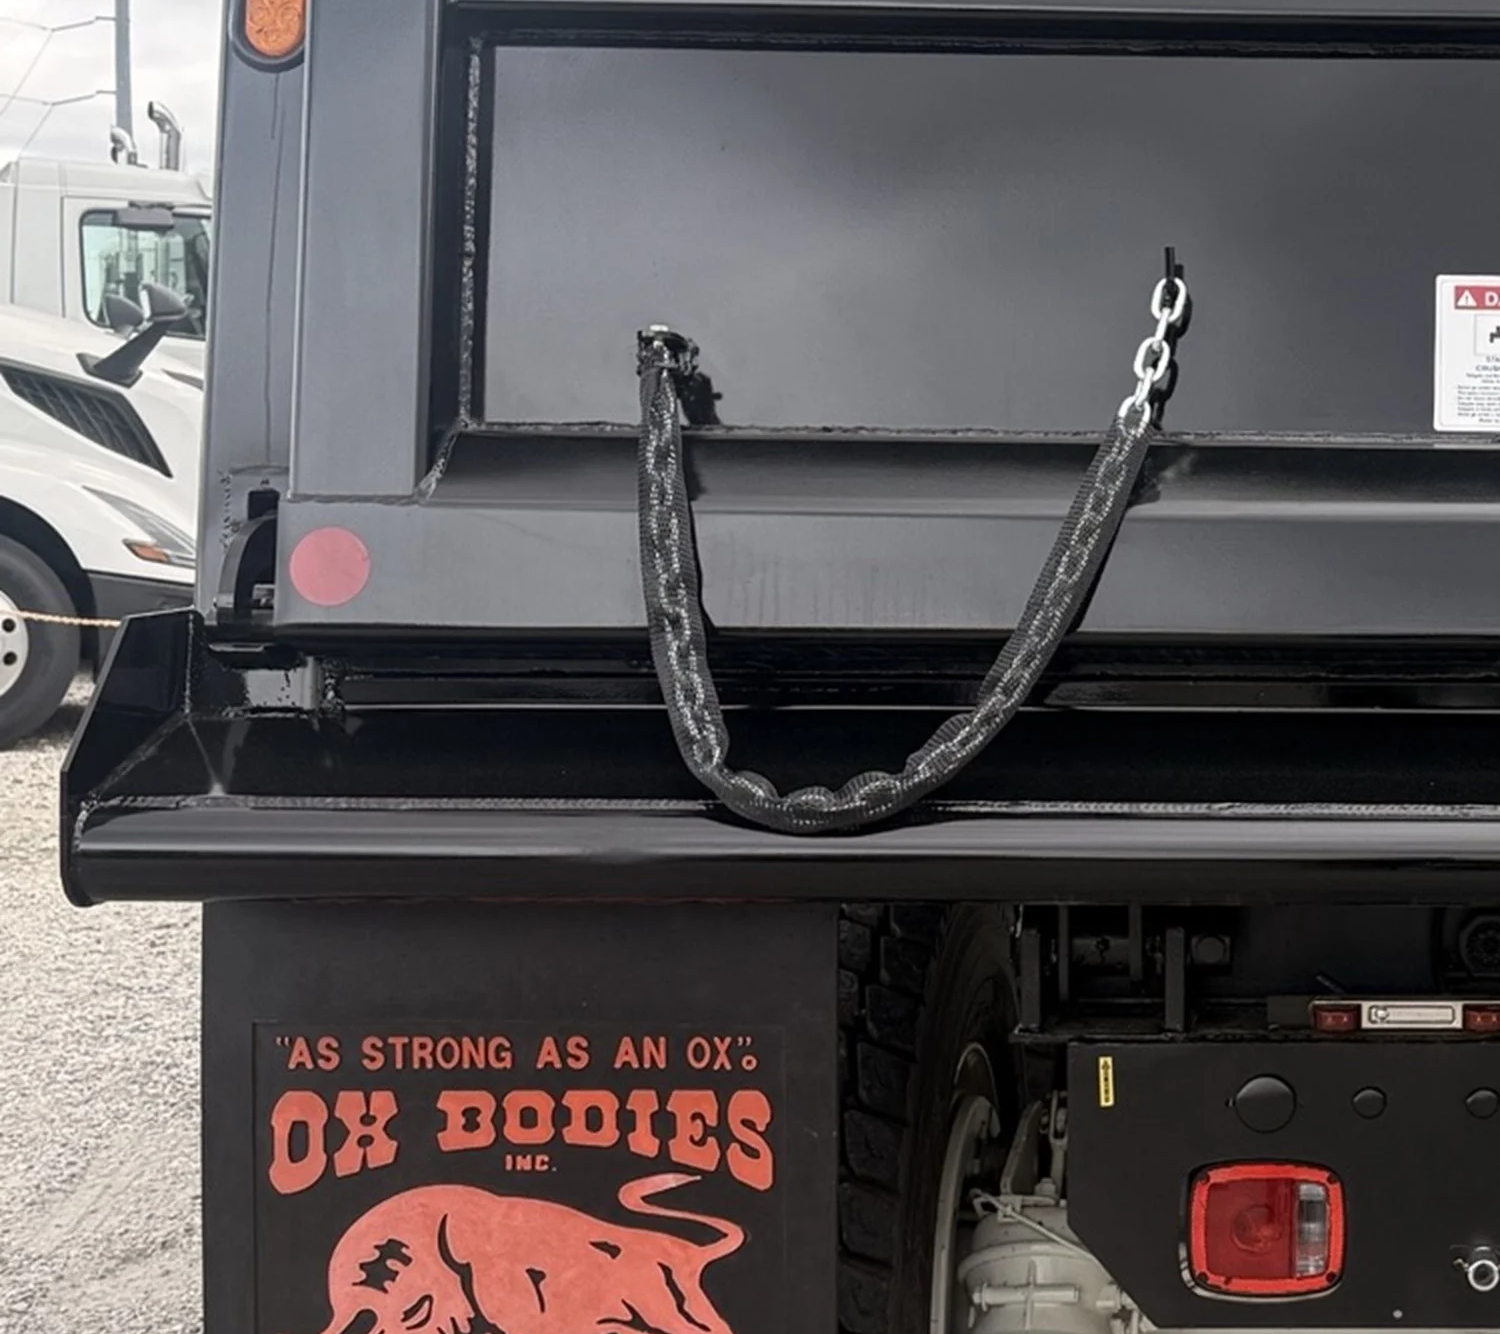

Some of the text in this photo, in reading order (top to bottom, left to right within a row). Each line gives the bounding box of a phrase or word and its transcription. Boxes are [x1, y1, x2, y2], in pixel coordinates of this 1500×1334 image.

[362, 1035, 513, 1070] STRONG
[536, 1035, 590, 1069] AS
[614, 1036, 667, 1069] AN
[269, 1089, 774, 1195] OX BODIES
[505, 1153, 557, 1172] INC.
